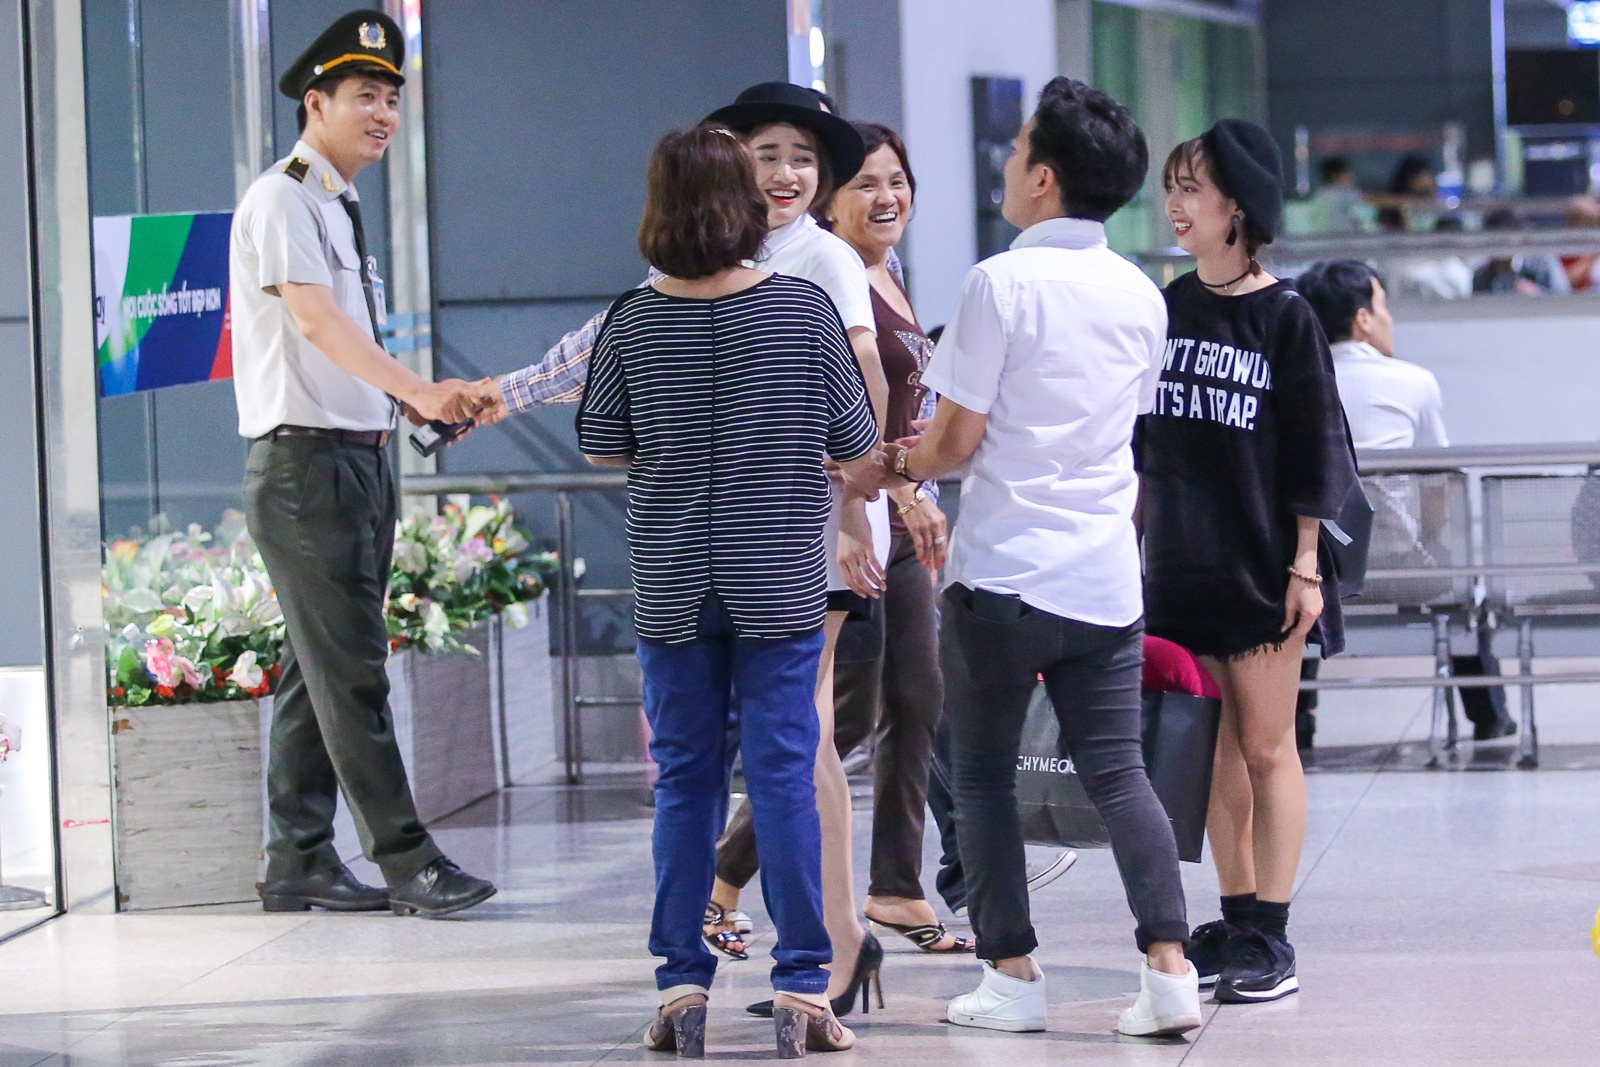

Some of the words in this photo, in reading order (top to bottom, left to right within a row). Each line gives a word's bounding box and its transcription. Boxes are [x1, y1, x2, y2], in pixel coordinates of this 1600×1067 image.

[138, 288, 157, 324] CUỘC
[158, 282, 178, 317] SỐNG
[178, 280, 191, 314] TỐT
[191, 289, 205, 318] ĐẸP
[1161, 339, 1195, 372] N'T
[1189, 384, 1203, 419] A
[1206, 387, 1257, 430] TRAP.
